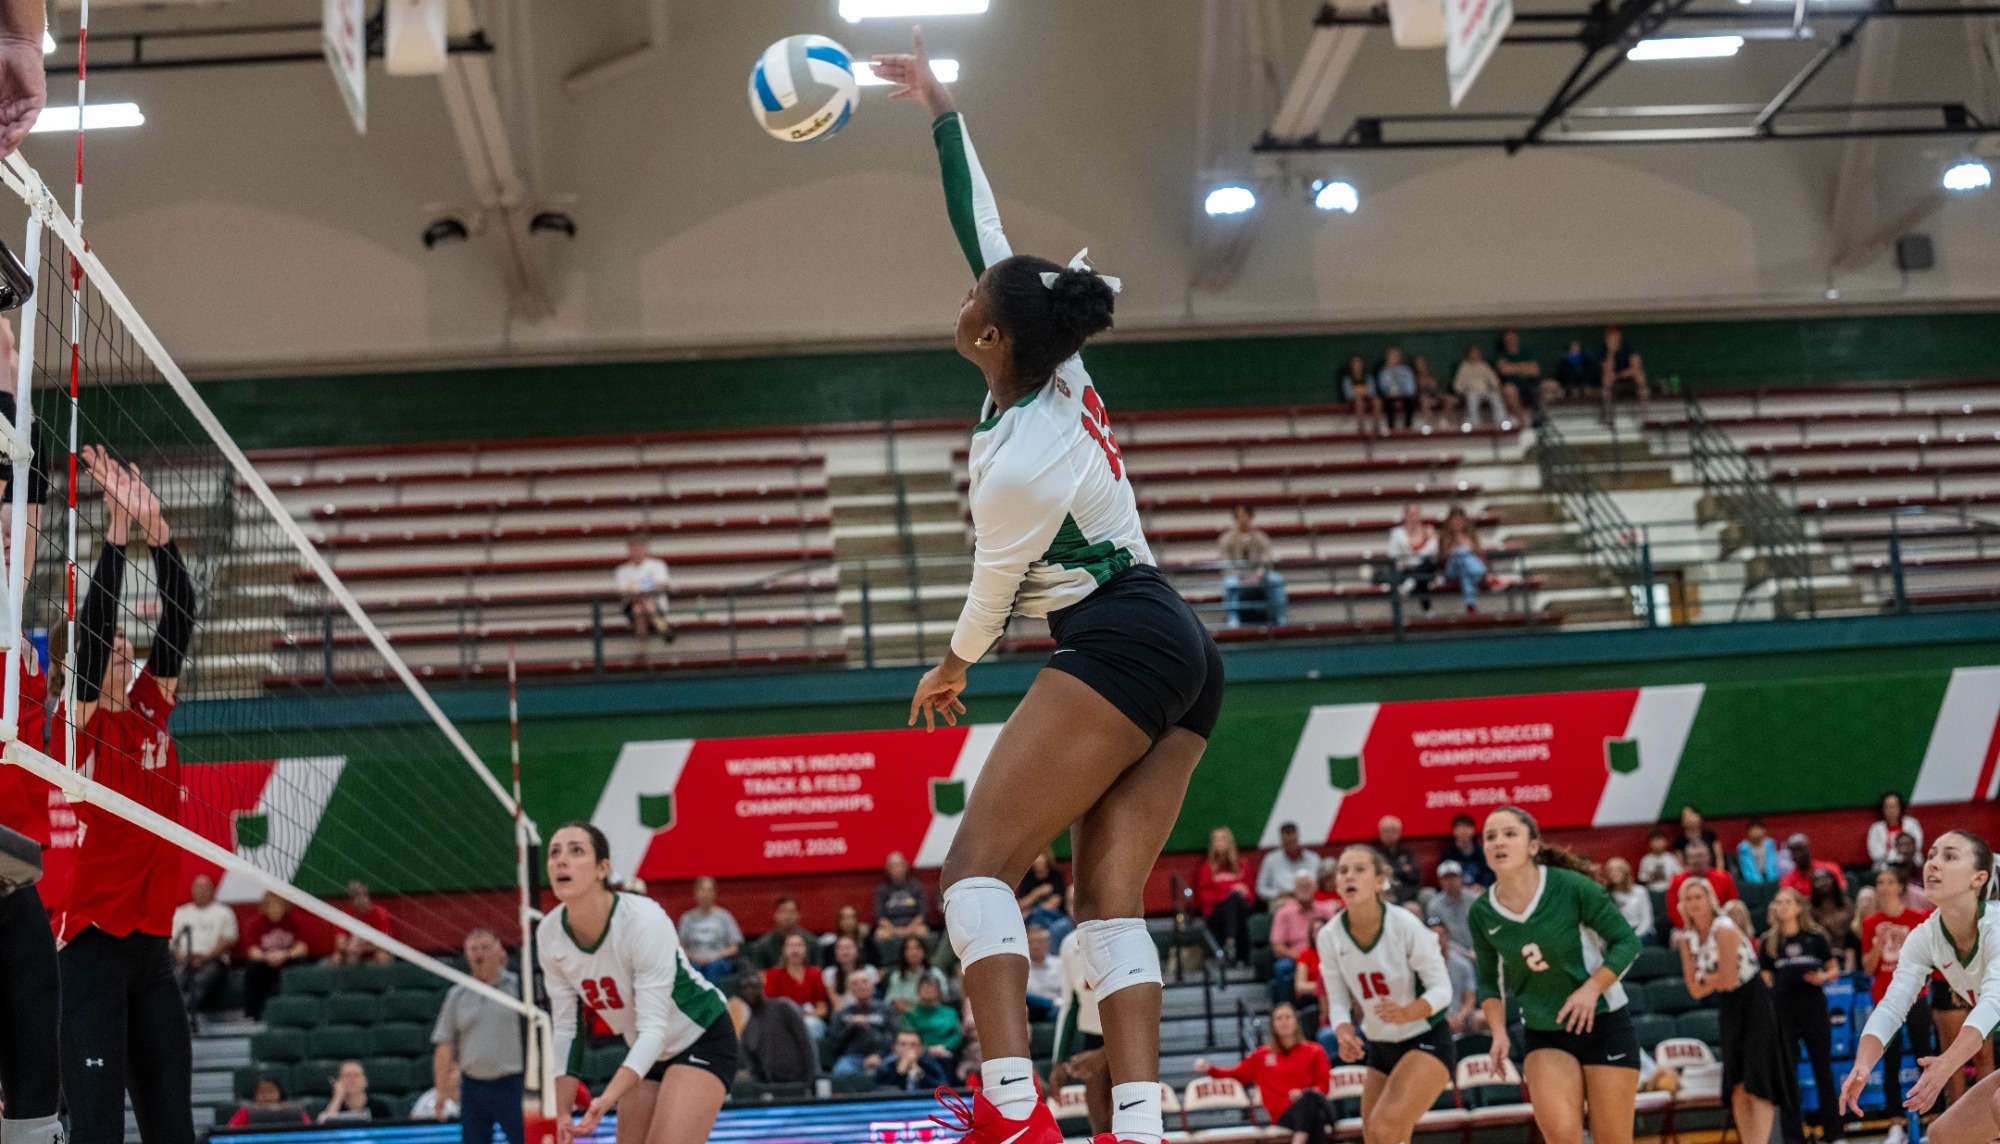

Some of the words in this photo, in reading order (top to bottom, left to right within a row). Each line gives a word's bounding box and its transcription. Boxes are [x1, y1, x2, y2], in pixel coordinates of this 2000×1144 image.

[1411, 727, 1490, 748] WOMEN'S
[1490, 723, 1554, 744] SOCCER
[725, 755, 807, 776] WOMEN'S
[808, 752, 875, 772] INDOOR
[1419, 743, 1550, 768] CHAMPIONSHIPS
[743, 776, 797, 796] TRACK
[798, 775, 813, 794] &
[814, 773, 861, 793] FIELD
[735, 794, 875, 818] CHAMPIONSHIPS
[1521, 942, 1551, 973] 2
[581, 976, 625, 1010] 23
[1358, 972, 1391, 1000] 16
